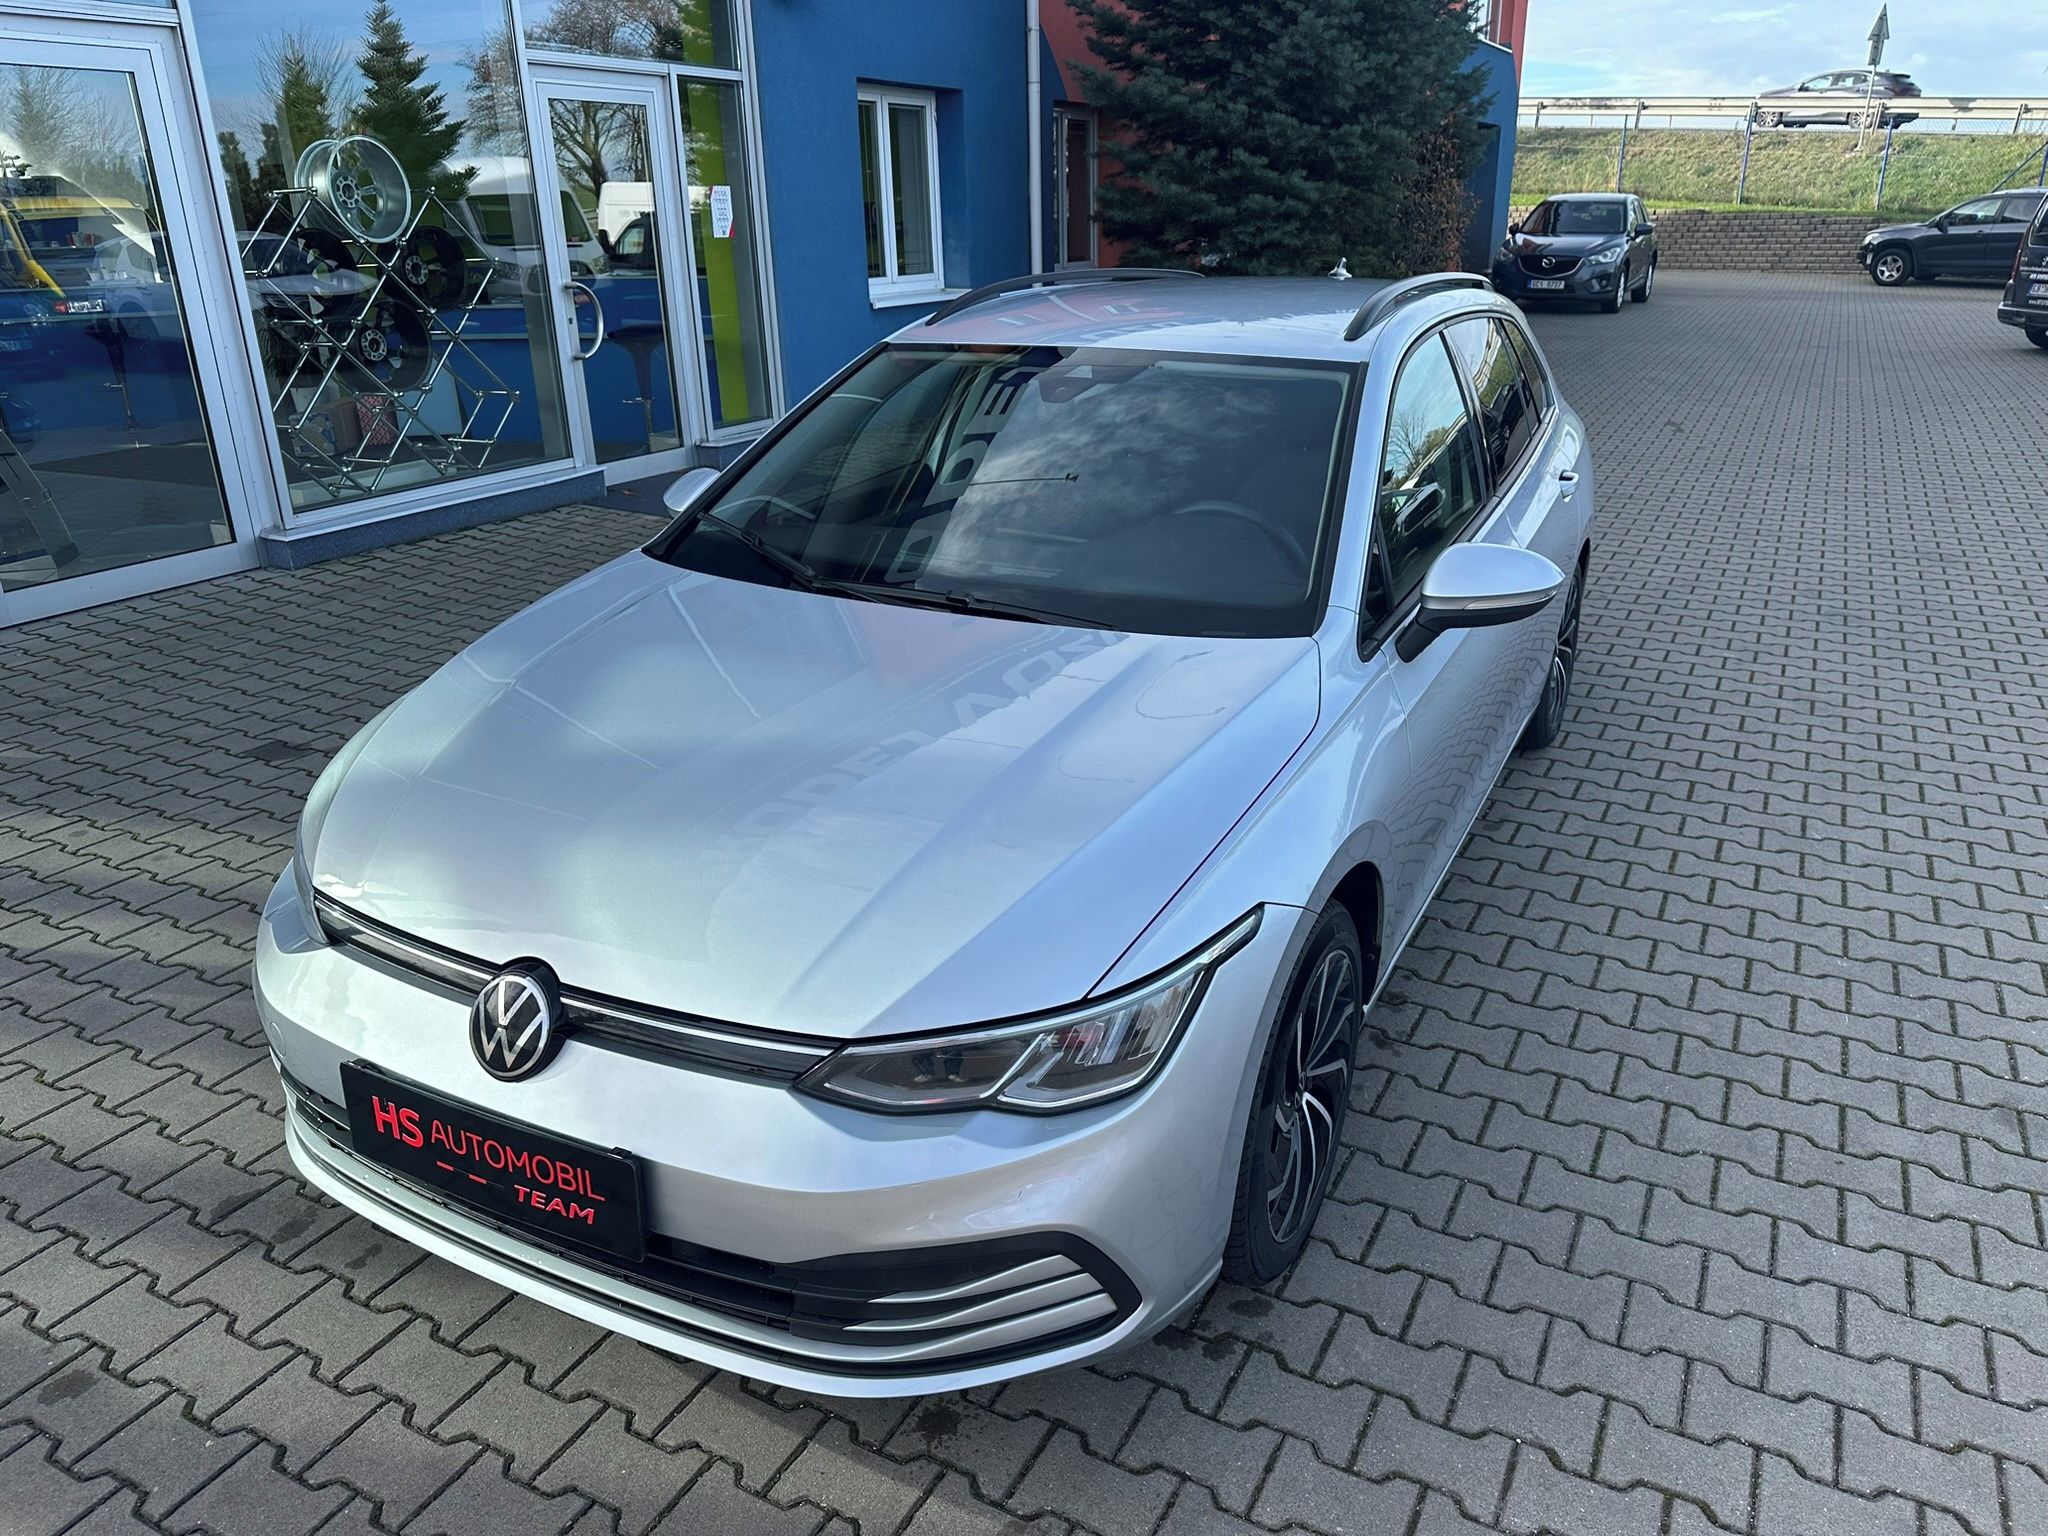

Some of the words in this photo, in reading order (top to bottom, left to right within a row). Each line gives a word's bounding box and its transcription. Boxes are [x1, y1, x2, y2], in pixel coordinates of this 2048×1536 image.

[372, 1095, 424, 1148] HS
[430, 1119, 606, 1201] AUTOMOBIL
[513, 1184, 595, 1226] TEAM
